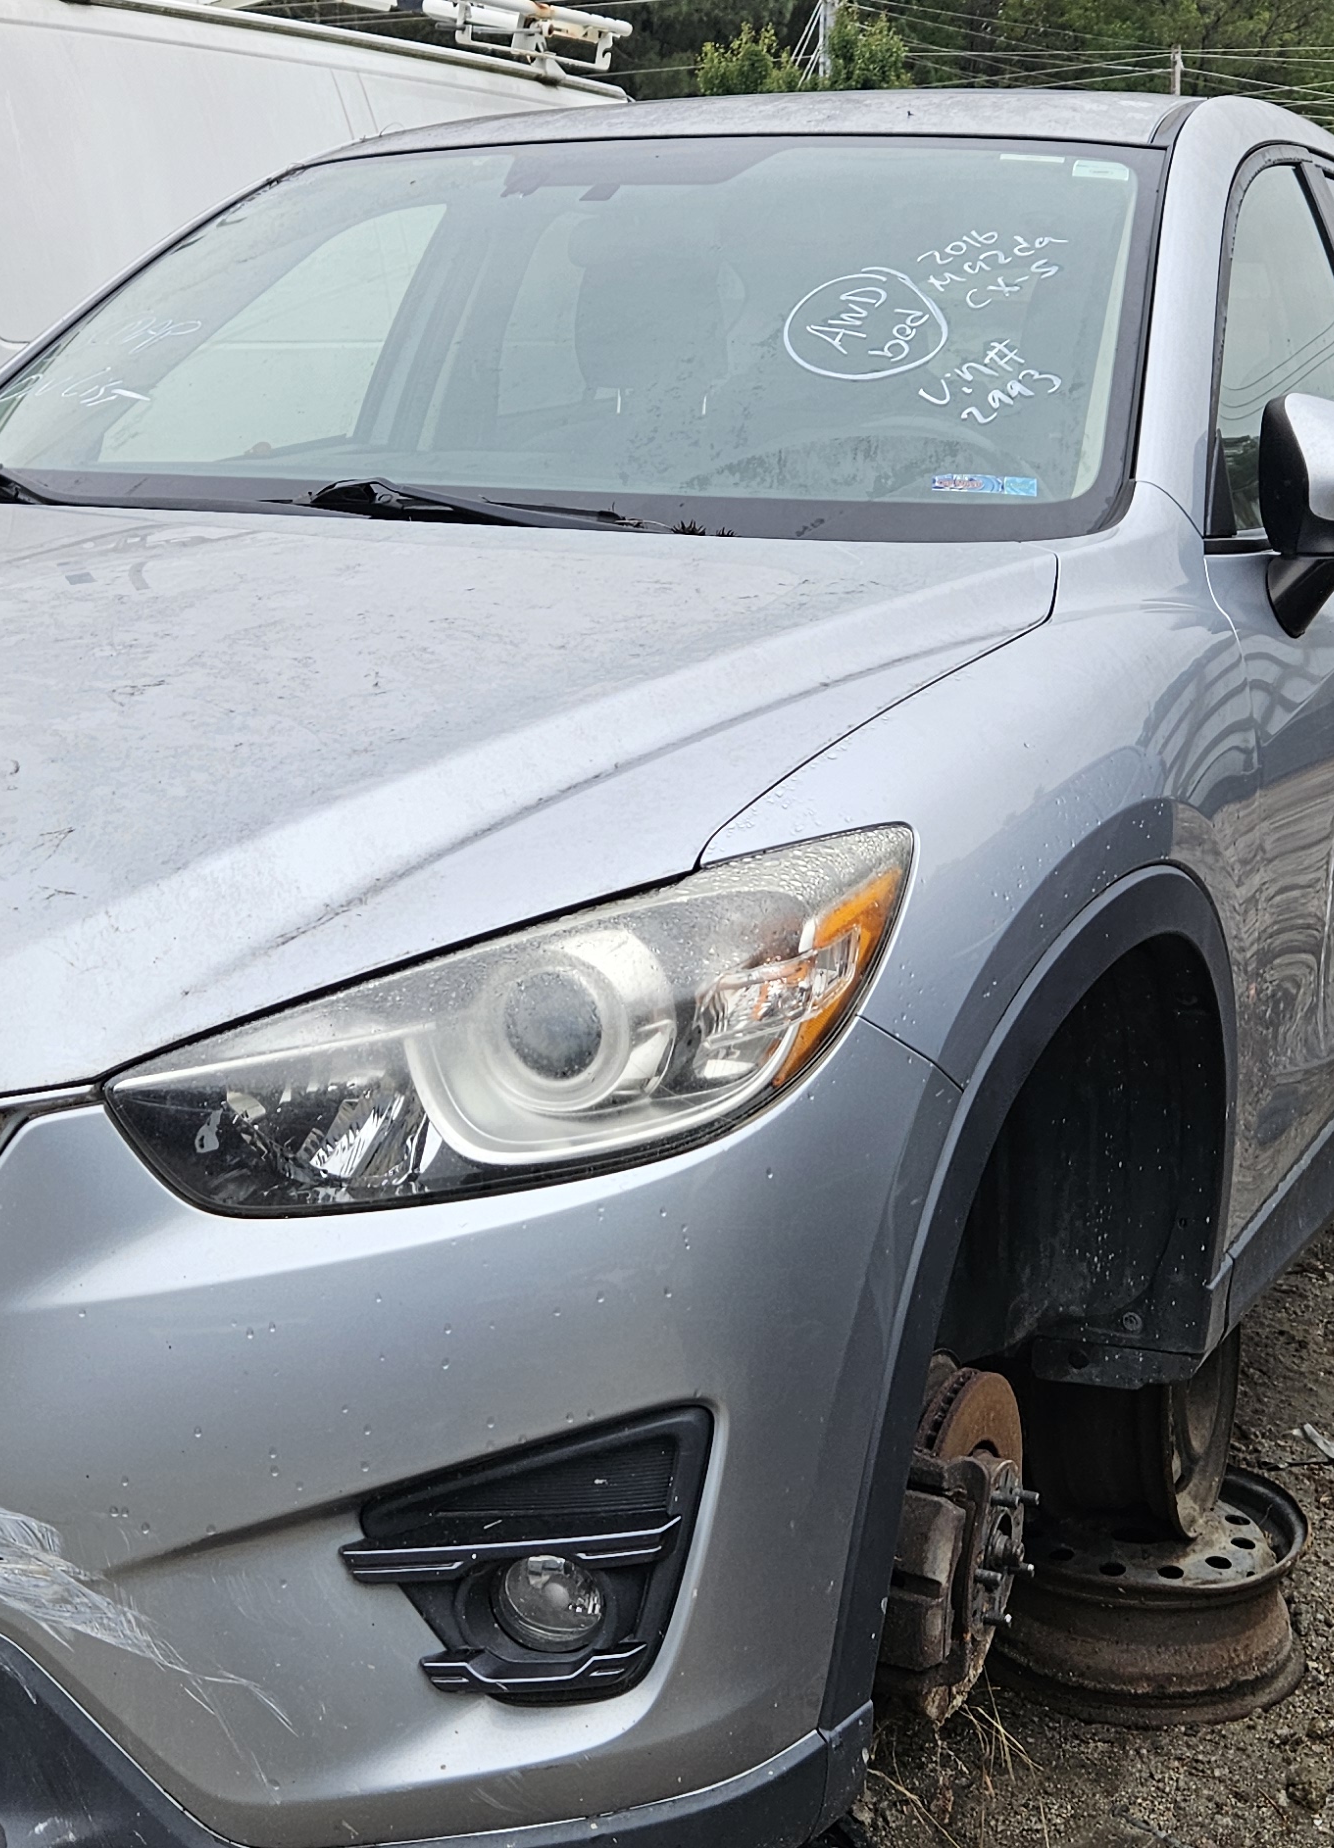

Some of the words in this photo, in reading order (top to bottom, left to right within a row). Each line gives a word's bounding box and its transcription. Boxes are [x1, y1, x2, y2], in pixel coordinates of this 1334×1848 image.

[917, 230, 999, 265] 2016
[928, 235, 1068, 292] Mazda
[806, 286, 888, 354] AWD
